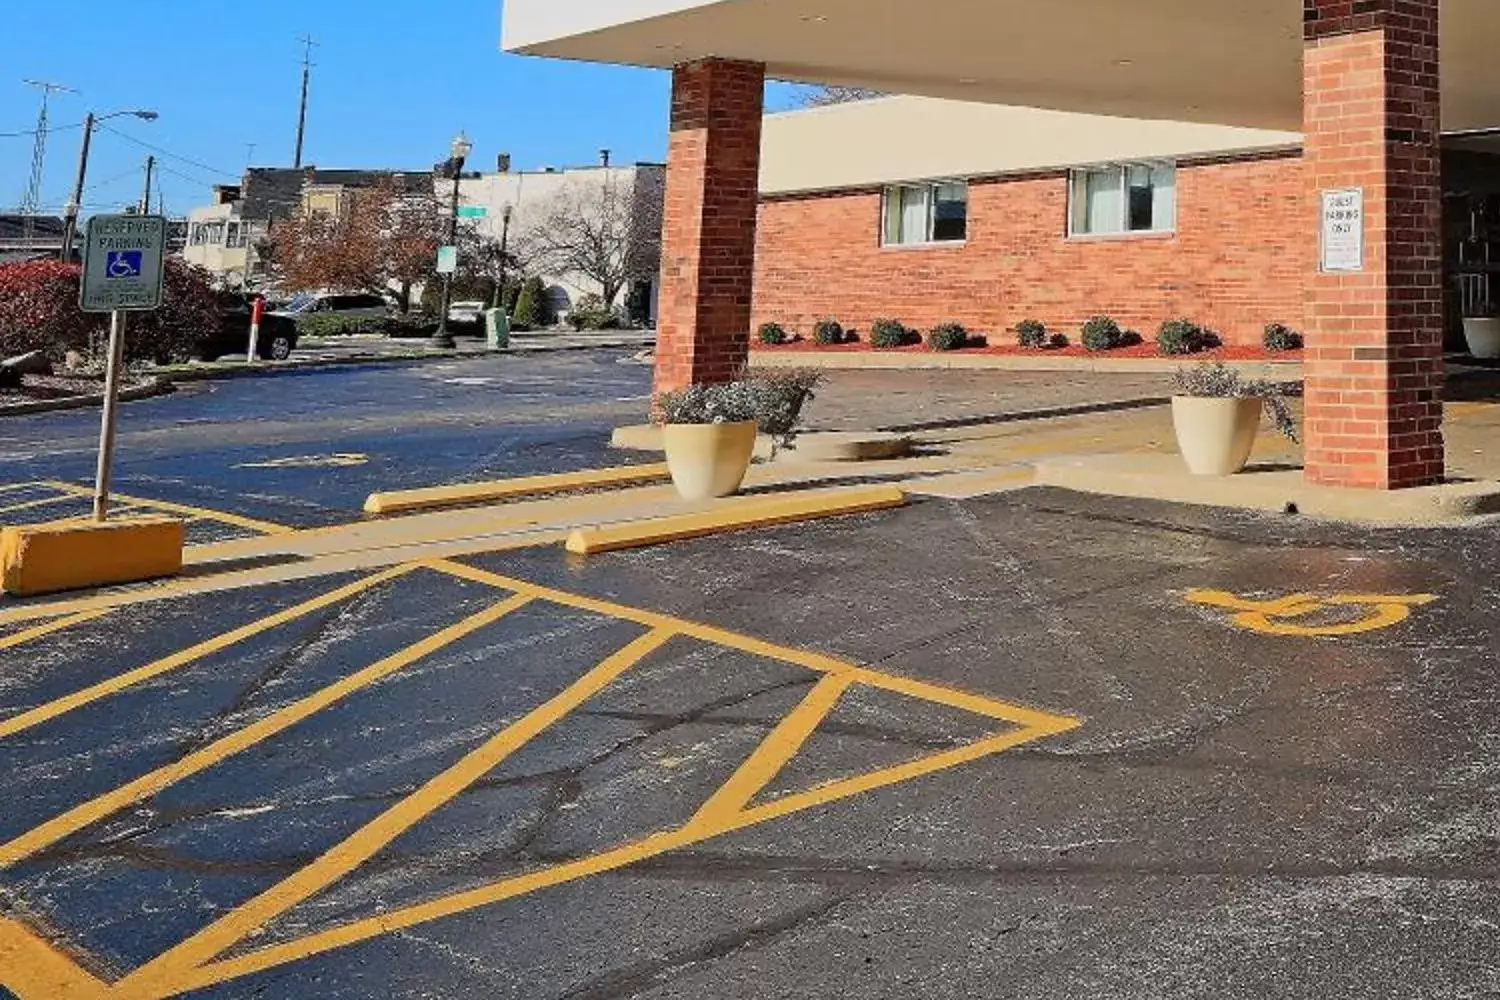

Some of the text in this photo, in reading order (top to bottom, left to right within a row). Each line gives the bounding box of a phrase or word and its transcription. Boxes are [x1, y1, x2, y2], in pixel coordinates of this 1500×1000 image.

[1326, 209, 1359, 221] PARKING
[94, 221, 158, 234] RESERVED
[99, 237, 152, 249] PARKING
